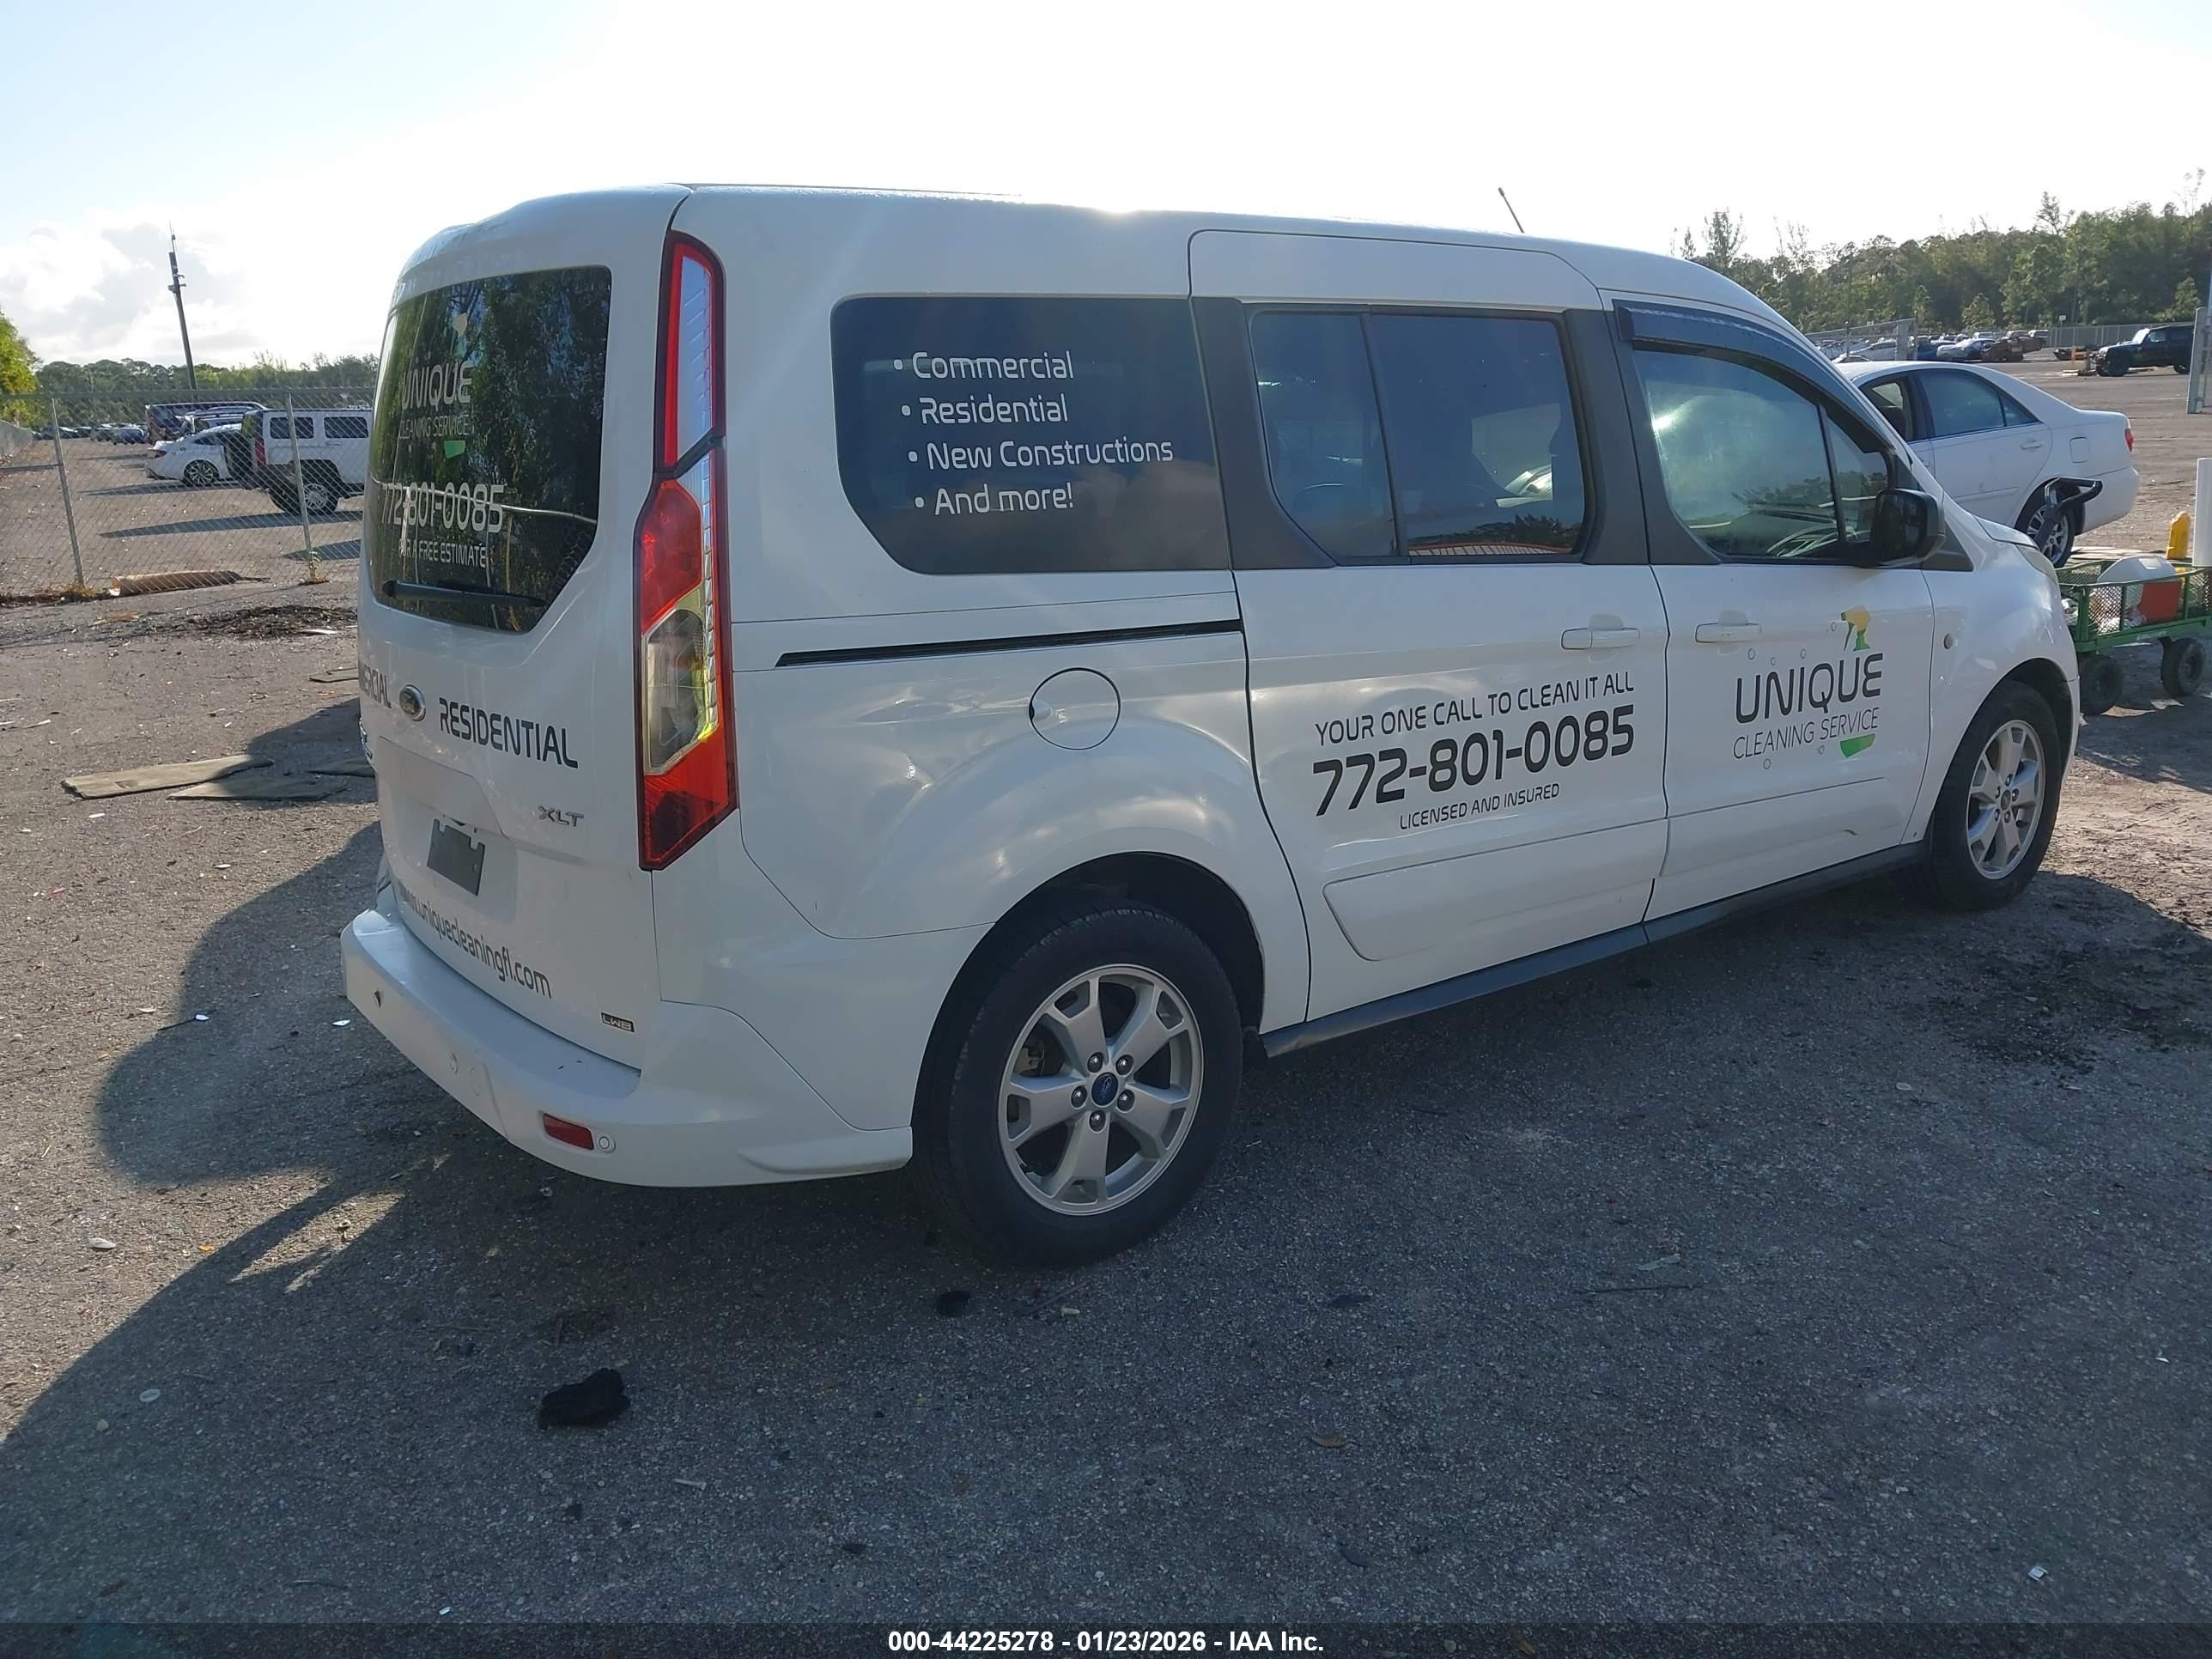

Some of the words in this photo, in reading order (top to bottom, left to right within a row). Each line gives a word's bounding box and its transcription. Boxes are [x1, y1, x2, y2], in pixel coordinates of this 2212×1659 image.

[401, 361, 473, 412] UNIQUE
[912, 350, 1073, 379] Commercial
[919, 393, 1068, 424] Residential
[927, 442, 992, 470] New
[1000, 436, 1174, 466] Constructions
[934, 483, 989, 515] And
[998, 482, 1073, 513] more!
[418, 540, 439, 562] FREE
[440, 542, 486, 568] ESTIMATE
[1315, 714, 1375, 746] YOUR
[1381, 706, 1427, 735] ONE
[1433, 696, 1483, 726] CALL
[1487, 691, 1511, 716] TO
[1517, 679, 1579, 710] CLEAN
[1585, 676, 1598, 700] IT
[1602, 672, 1634, 696] ALL
[1735, 653, 1883, 724] UNIQUE
[439, 697, 579, 769] RESIDENTIAL
[1733, 722, 1814, 759] CLEANING
[1820, 708, 1880, 740] SERVICE
[1313, 704, 1634, 817] 772-801-0085
[538, 805, 585, 827] XLT
[1400, 802, 1468, 830] LICENSED
[1471, 799, 1500, 817] AND
[1504, 783, 1560, 809] INSURED
[398, 878, 551, 999] .uniquecleaningfl.com
[603, 1014, 632, 1031] LWB
